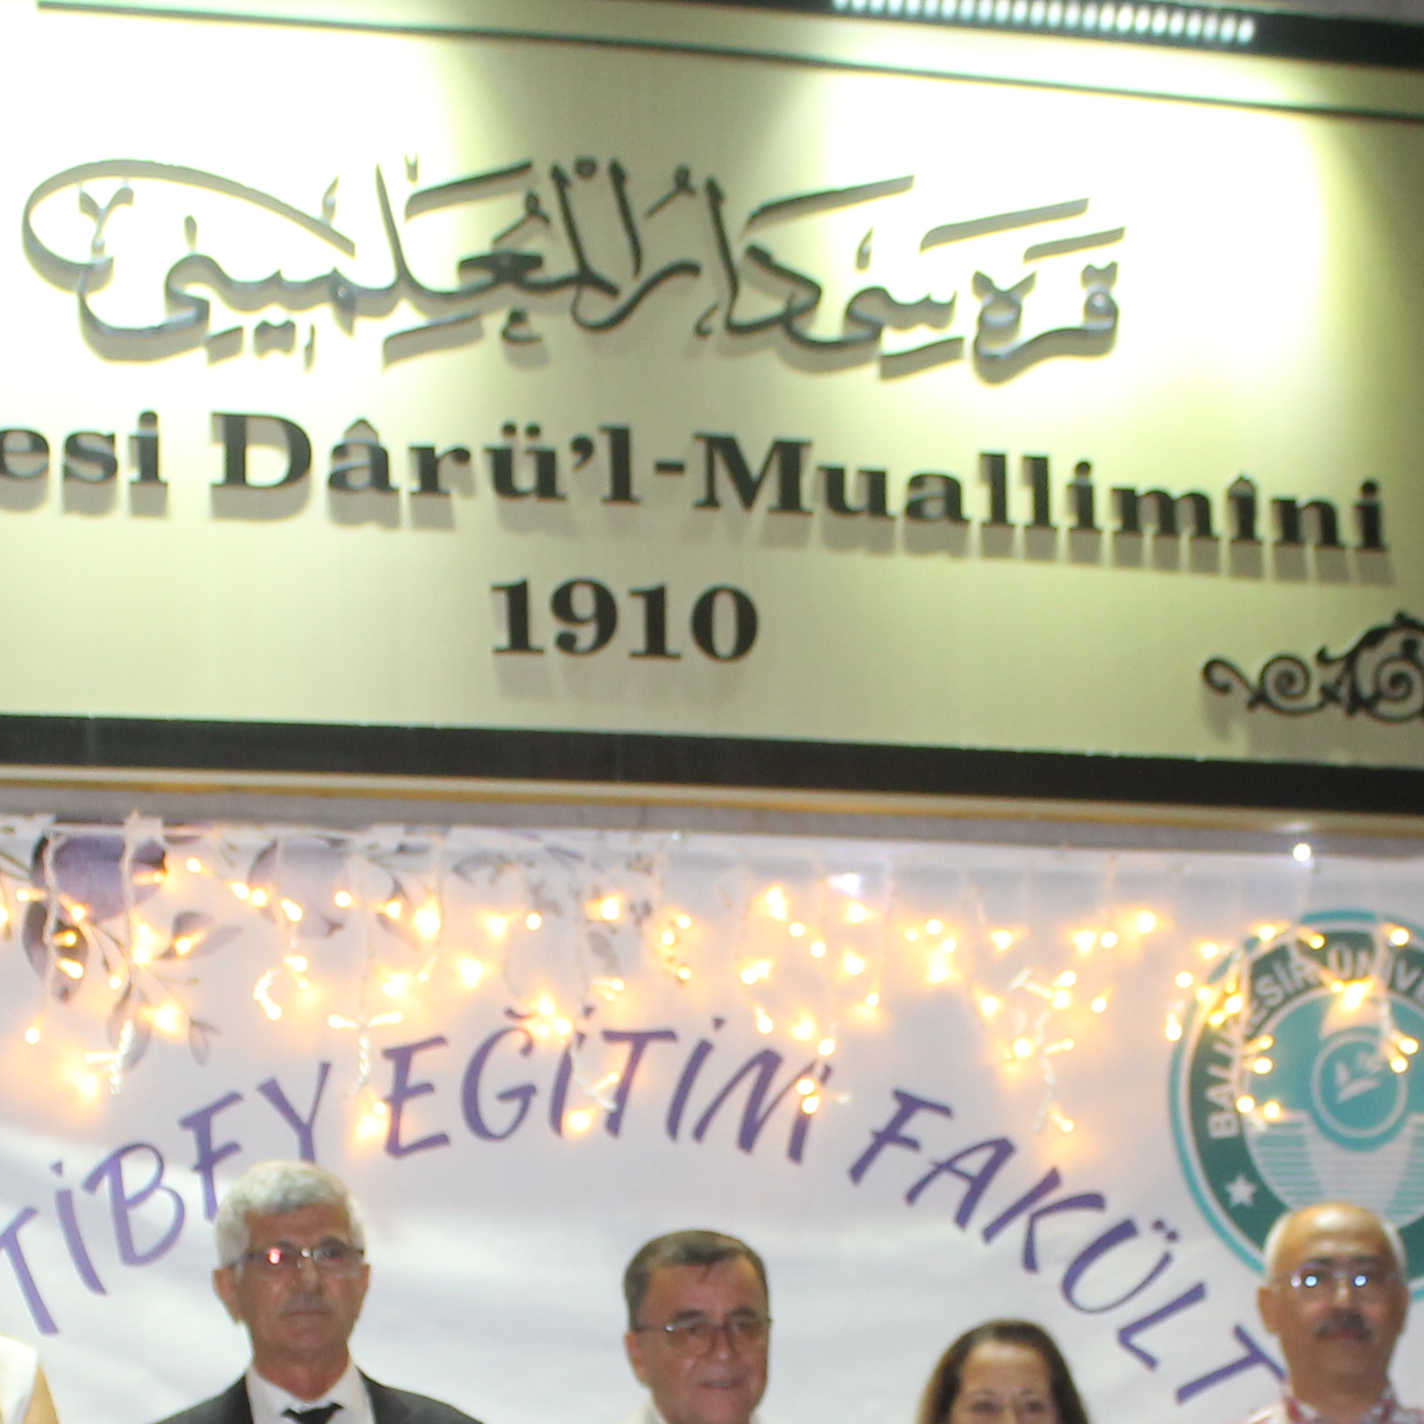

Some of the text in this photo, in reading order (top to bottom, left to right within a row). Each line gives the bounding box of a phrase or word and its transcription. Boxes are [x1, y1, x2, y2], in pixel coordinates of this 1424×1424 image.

[490, 577, 760, 661] 1910
[381, 1006, 833, 1165] EĞİTİM
[848, 1088, 1288, 1405] FAKÜLT
